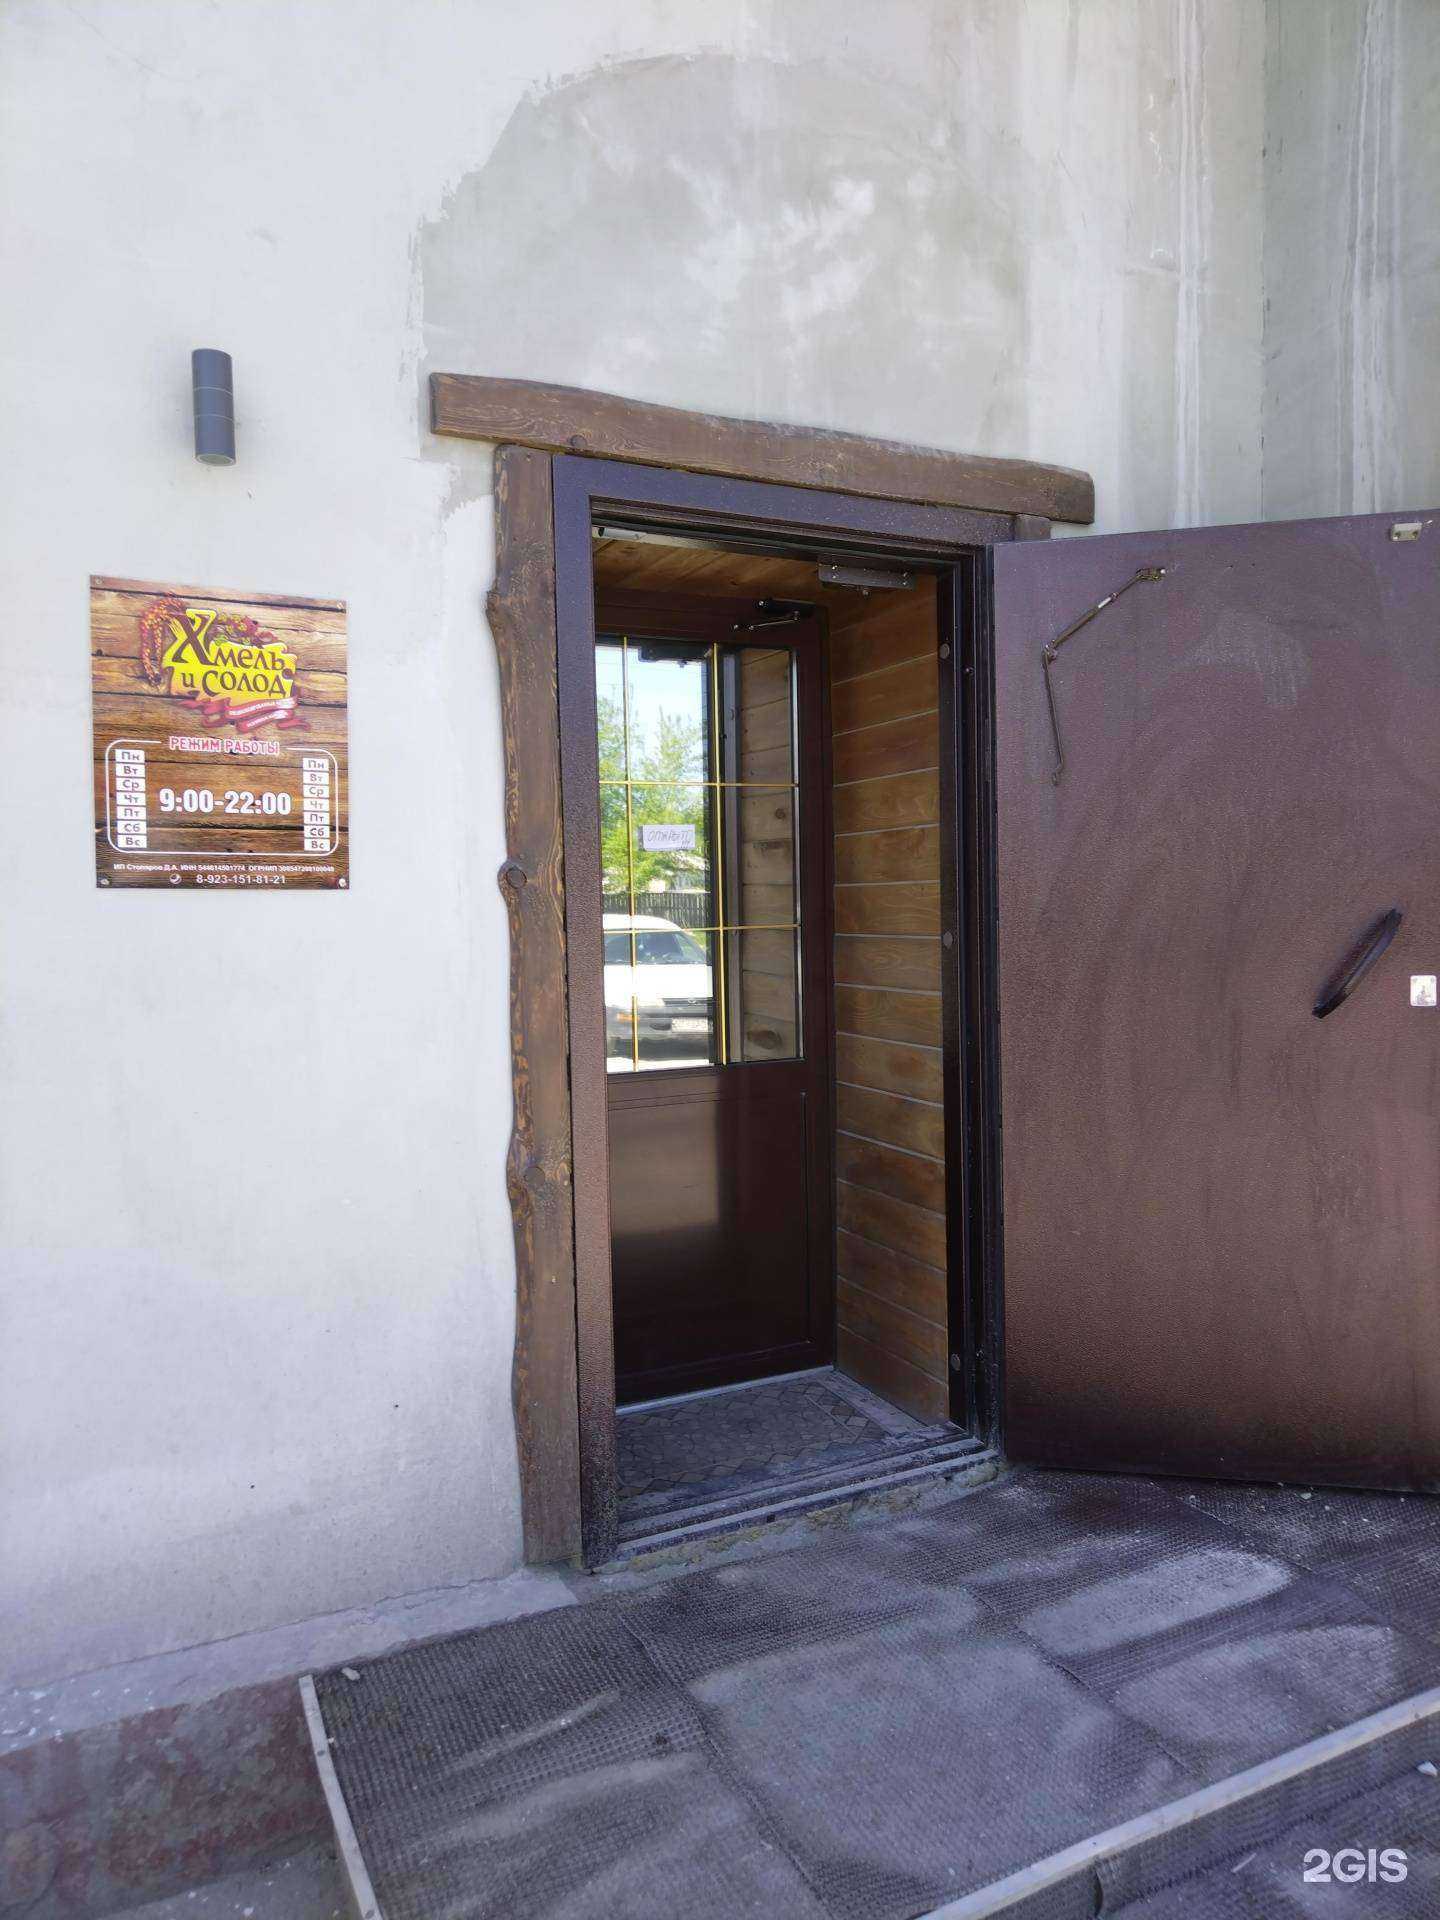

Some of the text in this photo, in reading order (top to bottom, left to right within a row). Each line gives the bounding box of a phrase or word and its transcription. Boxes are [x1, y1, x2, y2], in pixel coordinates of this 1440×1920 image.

[171, 613, 285, 671] Хмель
[181, 670, 286, 698] и Солод
[170, 736, 280, 756] РЕЖИМ РАБОТЫ
[121, 751, 140, 760] Пн
[308, 760, 324, 768] Пн
[123, 765, 138, 775] Вт
[310, 773, 322, 782] Вт
[122, 780, 140, 792] Ср
[309, 786, 324, 797] Ср
[124, 794, 139, 803] Чт
[159, 788, 292, 815] 9:00-22:00
[310, 800, 323, 809] Чт
[124, 808, 140, 817] Пт
[310, 813, 324, 822] Пт
[124, 823, 140, 832] Сб
[309, 828, 324, 836] Сб
[125, 837, 140, 846] Вс
[311, 840, 324, 849] Вс
[196, 874, 287, 885] 8-923-151-81-21
